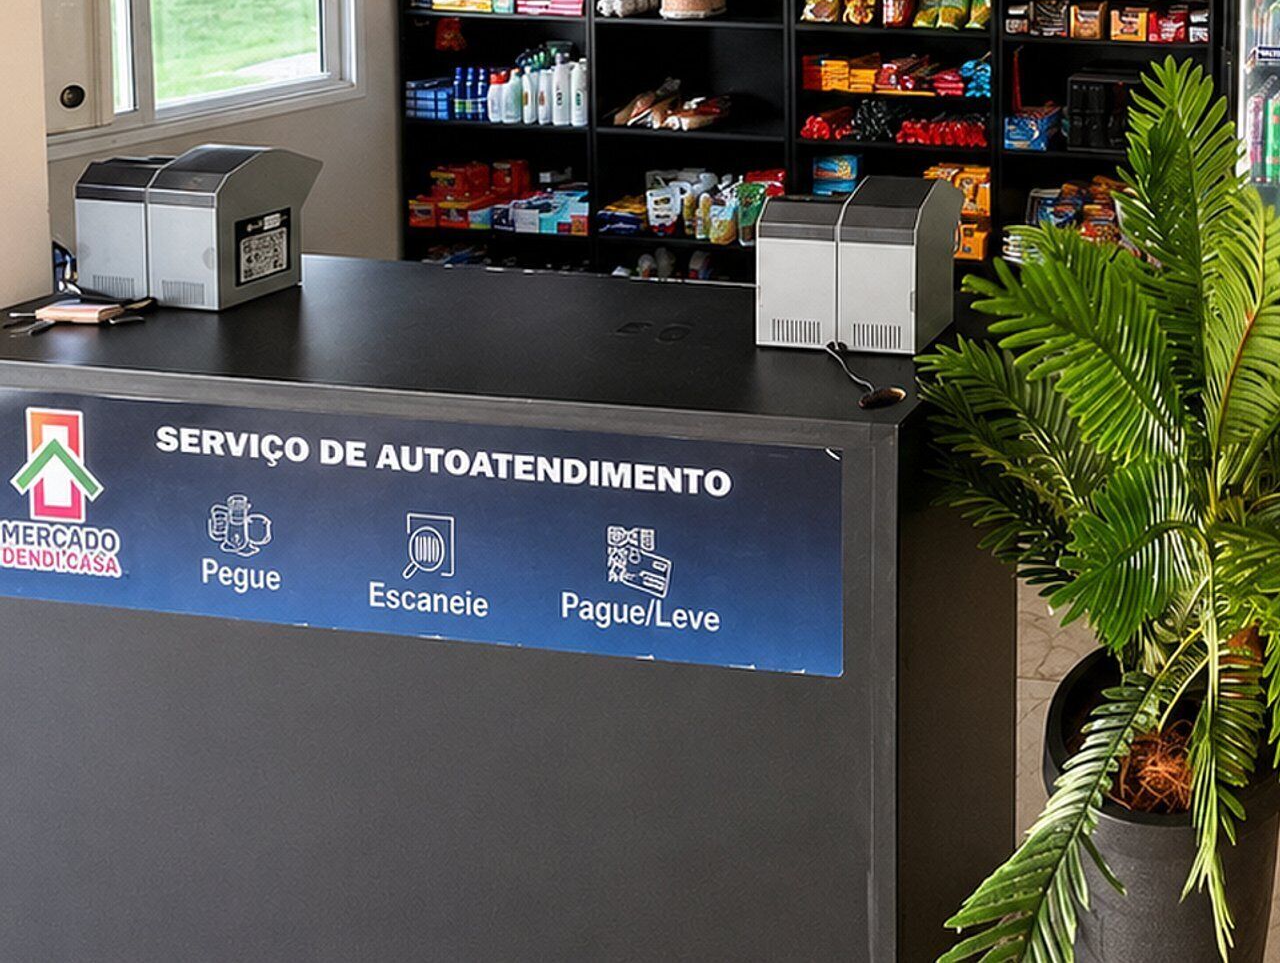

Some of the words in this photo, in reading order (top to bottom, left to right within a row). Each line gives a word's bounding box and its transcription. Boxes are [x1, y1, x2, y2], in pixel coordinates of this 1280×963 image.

[156, 425, 310, 467] SERVIÇO
[320, 438, 368, 468] DE
[374, 443, 733, 498] AUTOATENDIMENTO
[1, 522, 117, 554] MERCADO
[1, 546, 119, 575] DENDI.CASA
[201, 557, 281, 593] Pegue
[368, 580, 489, 618] Escaneie
[560, 590, 721, 633] Pague/Leve
